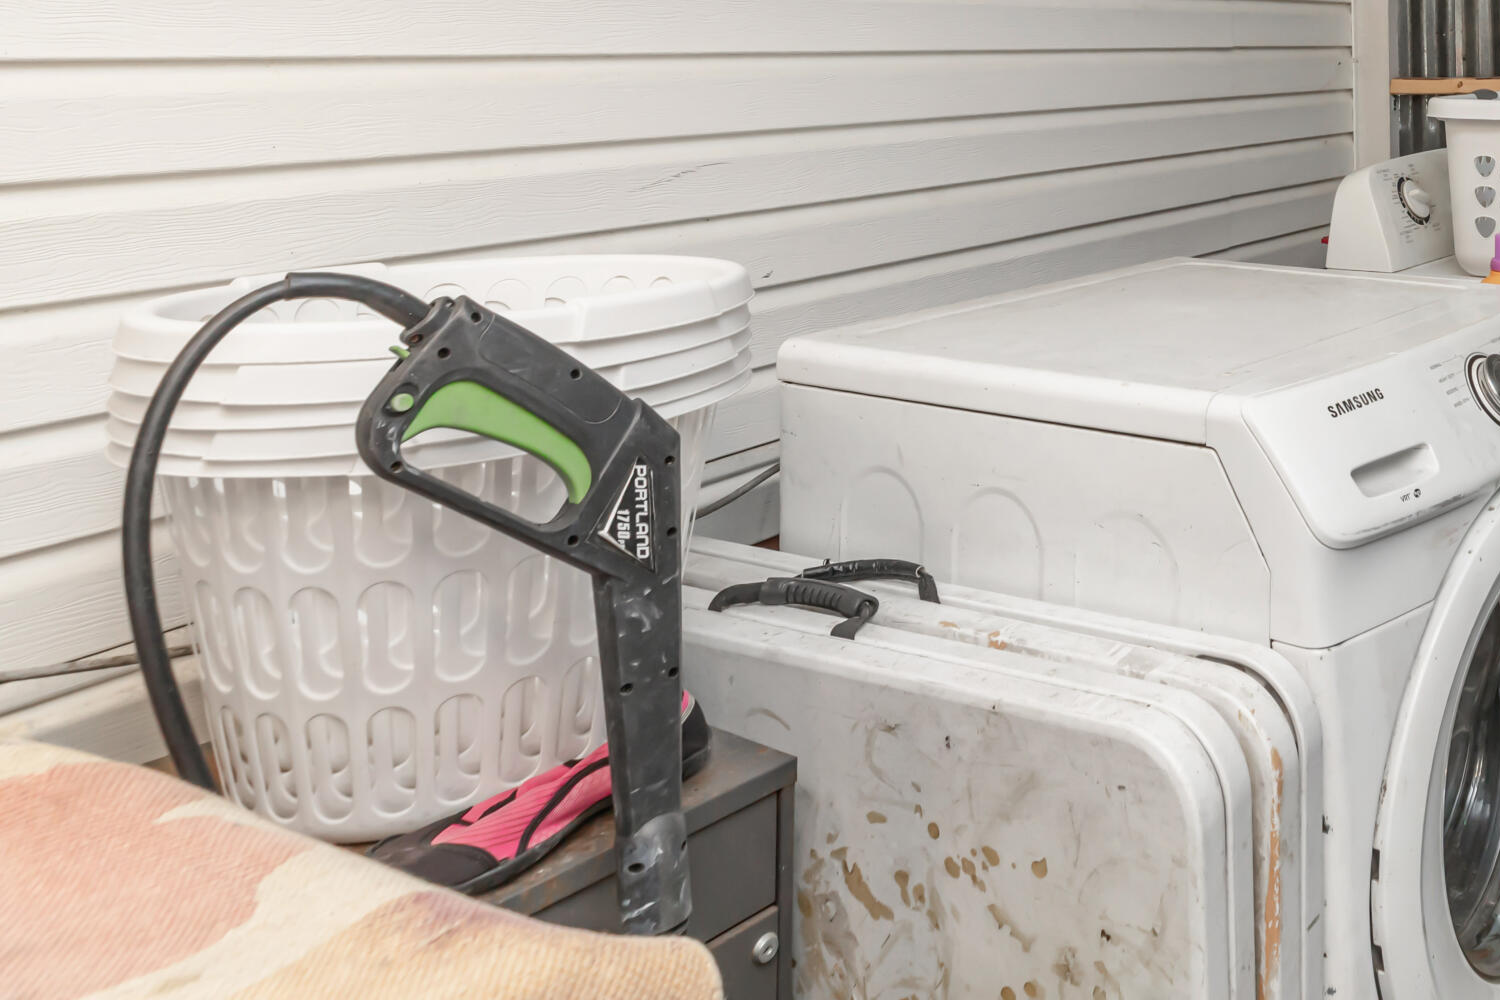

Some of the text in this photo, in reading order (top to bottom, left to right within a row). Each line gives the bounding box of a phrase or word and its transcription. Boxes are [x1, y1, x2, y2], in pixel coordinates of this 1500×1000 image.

[1327, 388, 1384, 418] SAMSUNG
[617, 509, 631, 539] 1750
[634, 464, 650, 559] PORTLAND
